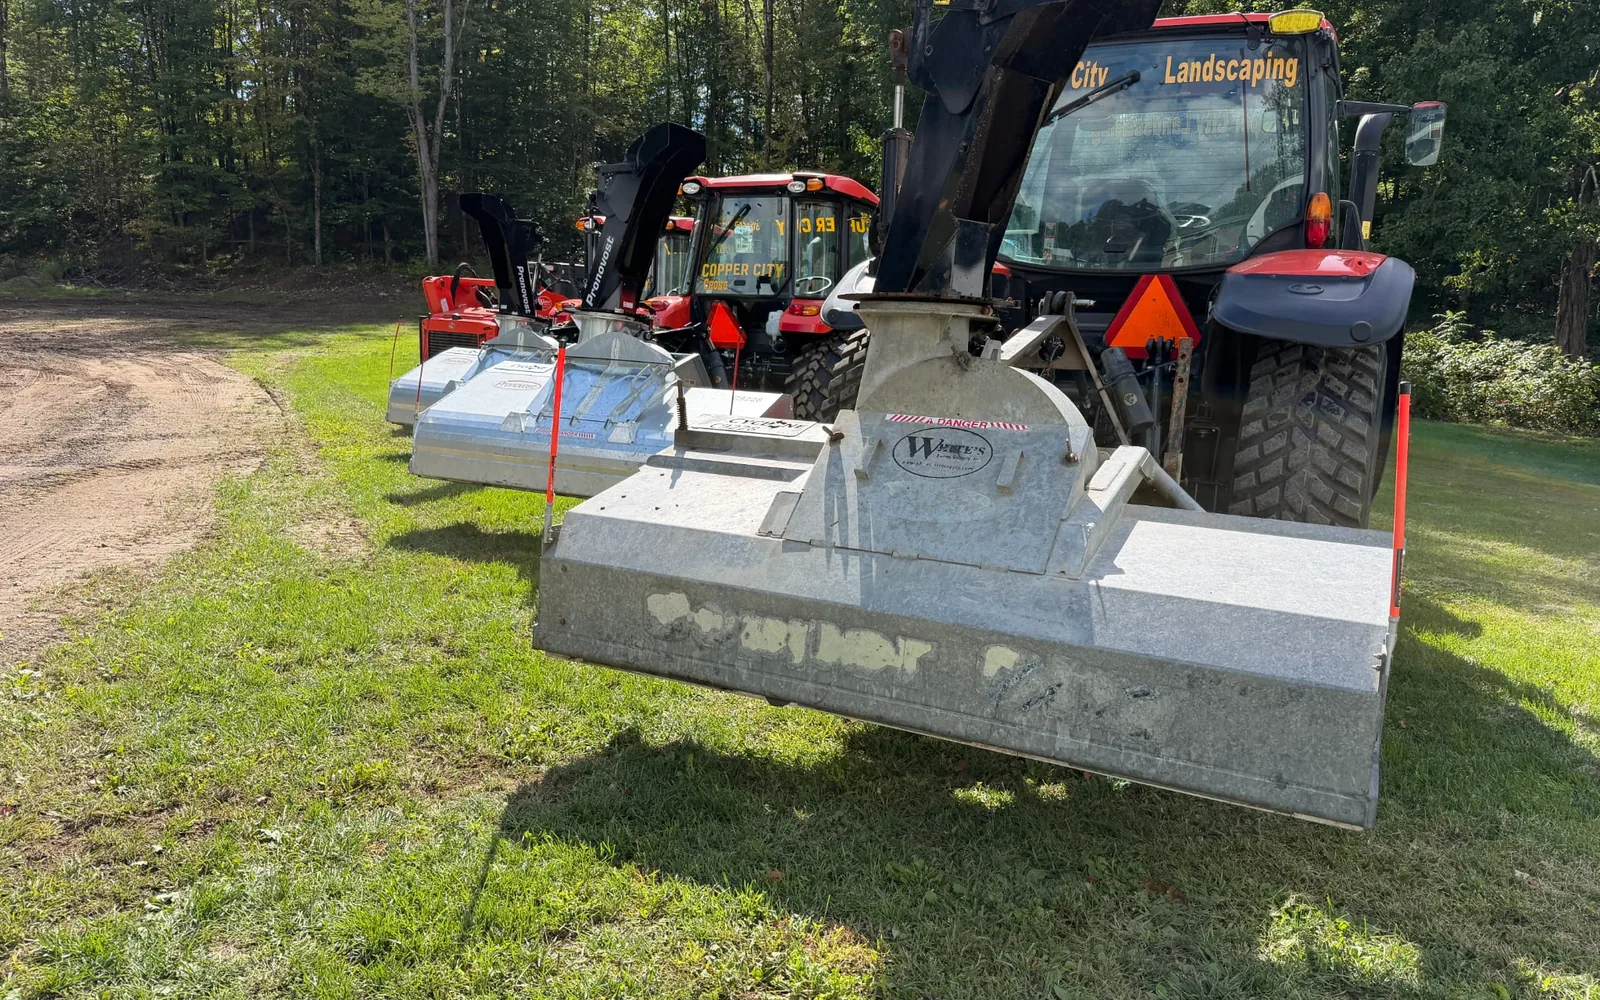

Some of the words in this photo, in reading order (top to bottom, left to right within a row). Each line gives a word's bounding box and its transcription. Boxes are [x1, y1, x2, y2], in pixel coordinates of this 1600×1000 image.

[1071, 60, 1109, 89] City
[1164, 51, 1298, 88] Landscaping
[517, 265, 531, 314] Pronovost
[586, 235, 615, 307] Pronovost
[702, 263, 749, 278] COPPER
[753, 263, 784, 279] CITY
[937, 418, 988, 429] DANGER
